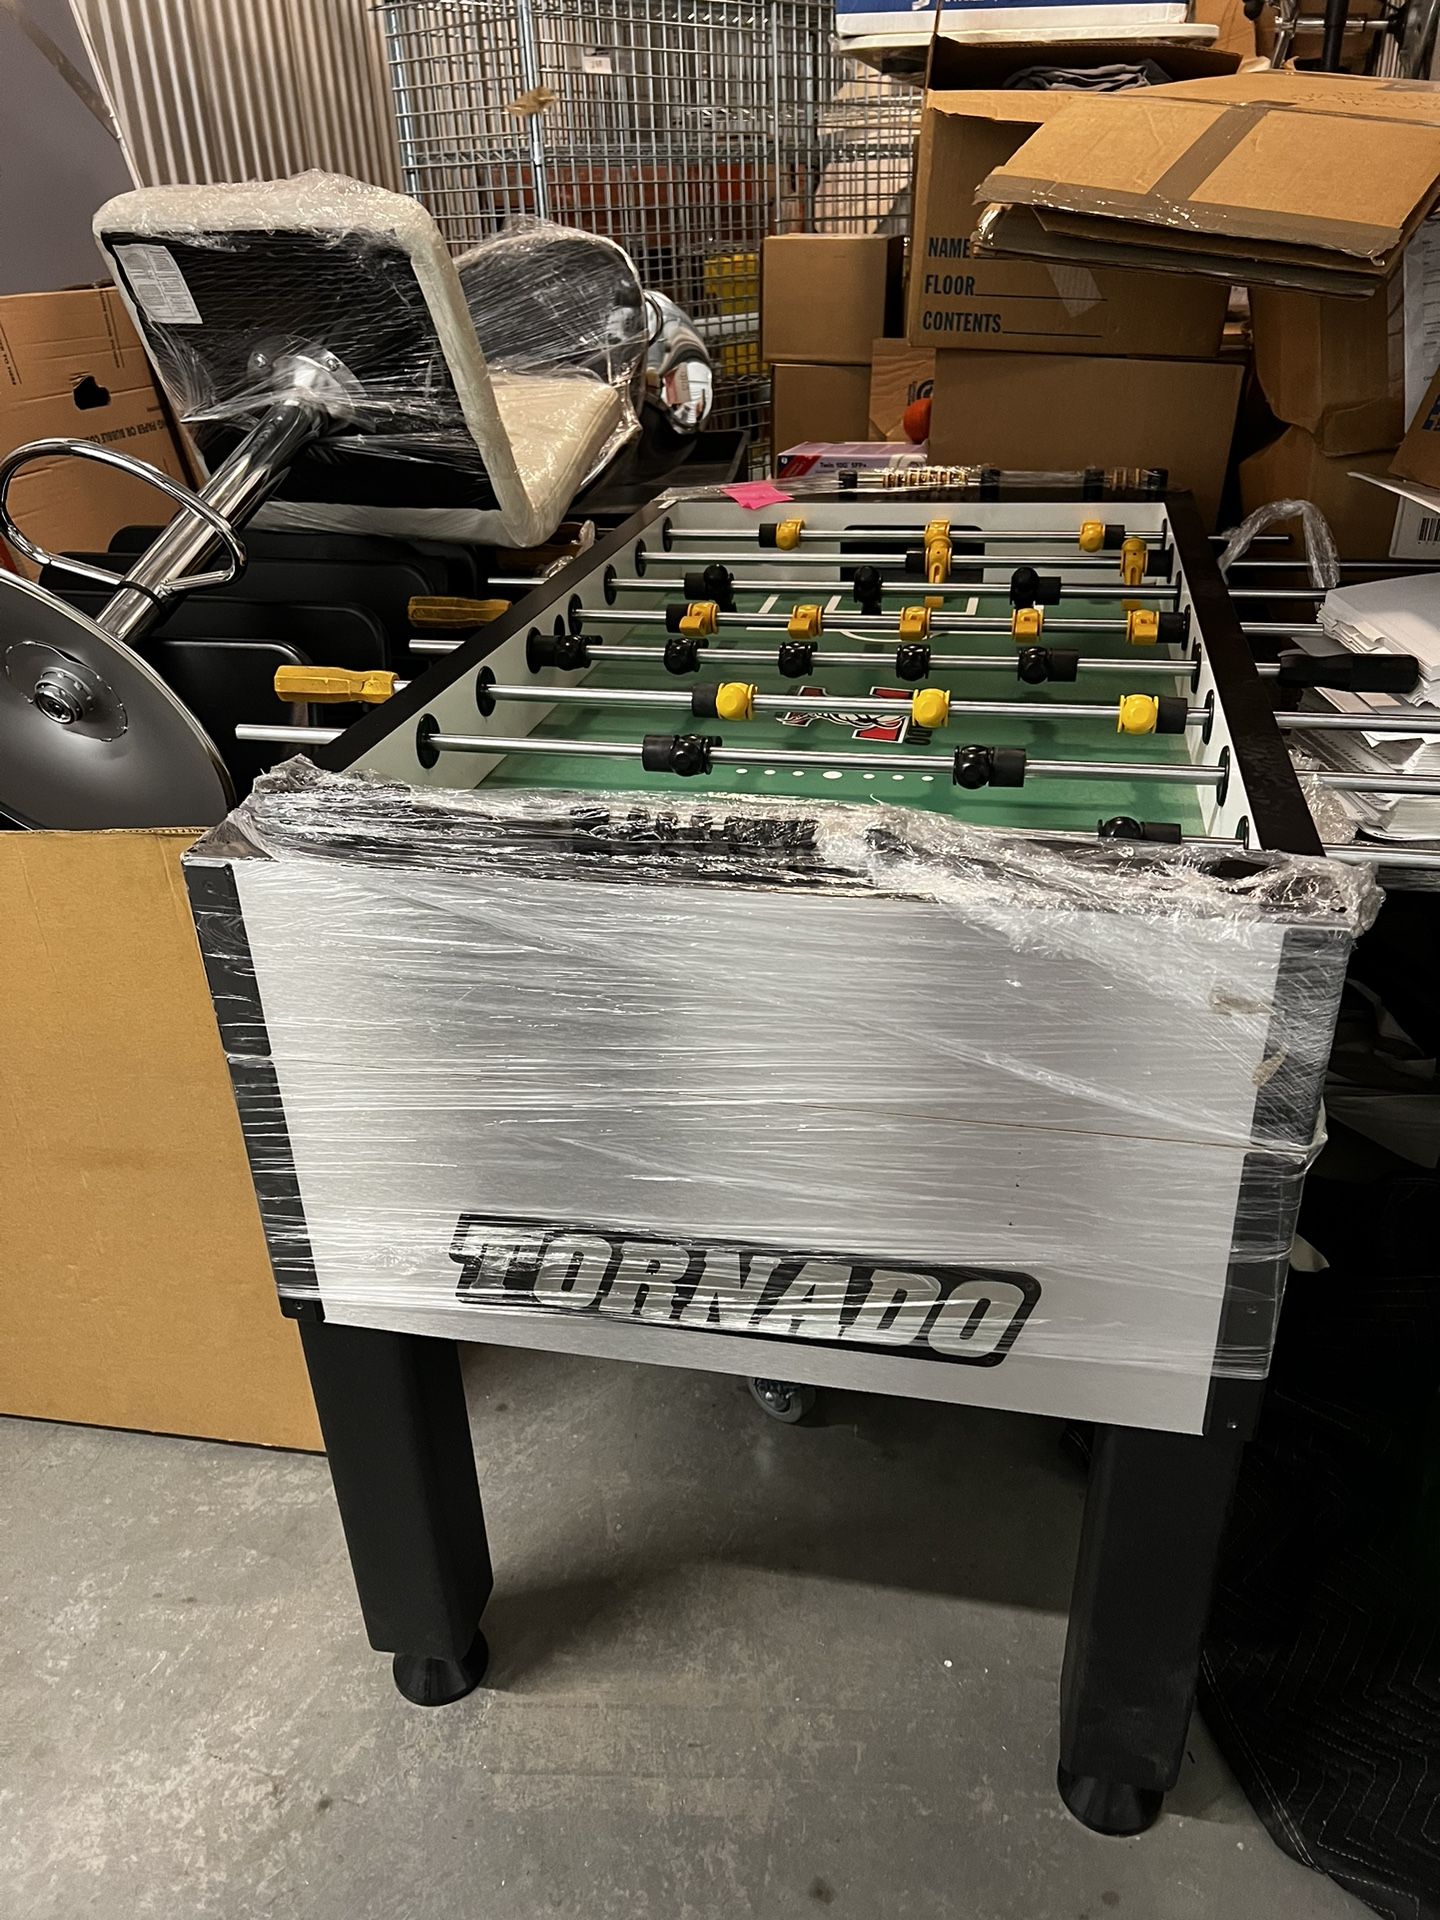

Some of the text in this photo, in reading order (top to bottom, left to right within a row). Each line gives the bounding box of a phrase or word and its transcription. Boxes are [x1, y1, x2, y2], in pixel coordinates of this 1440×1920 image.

[928, 236, 971, 259] NAME
[924, 274, 975, 296] FLOOR
[922, 310, 1002, 333] CONTENTS
[452, 1216, 1028, 1358] TORNADO
